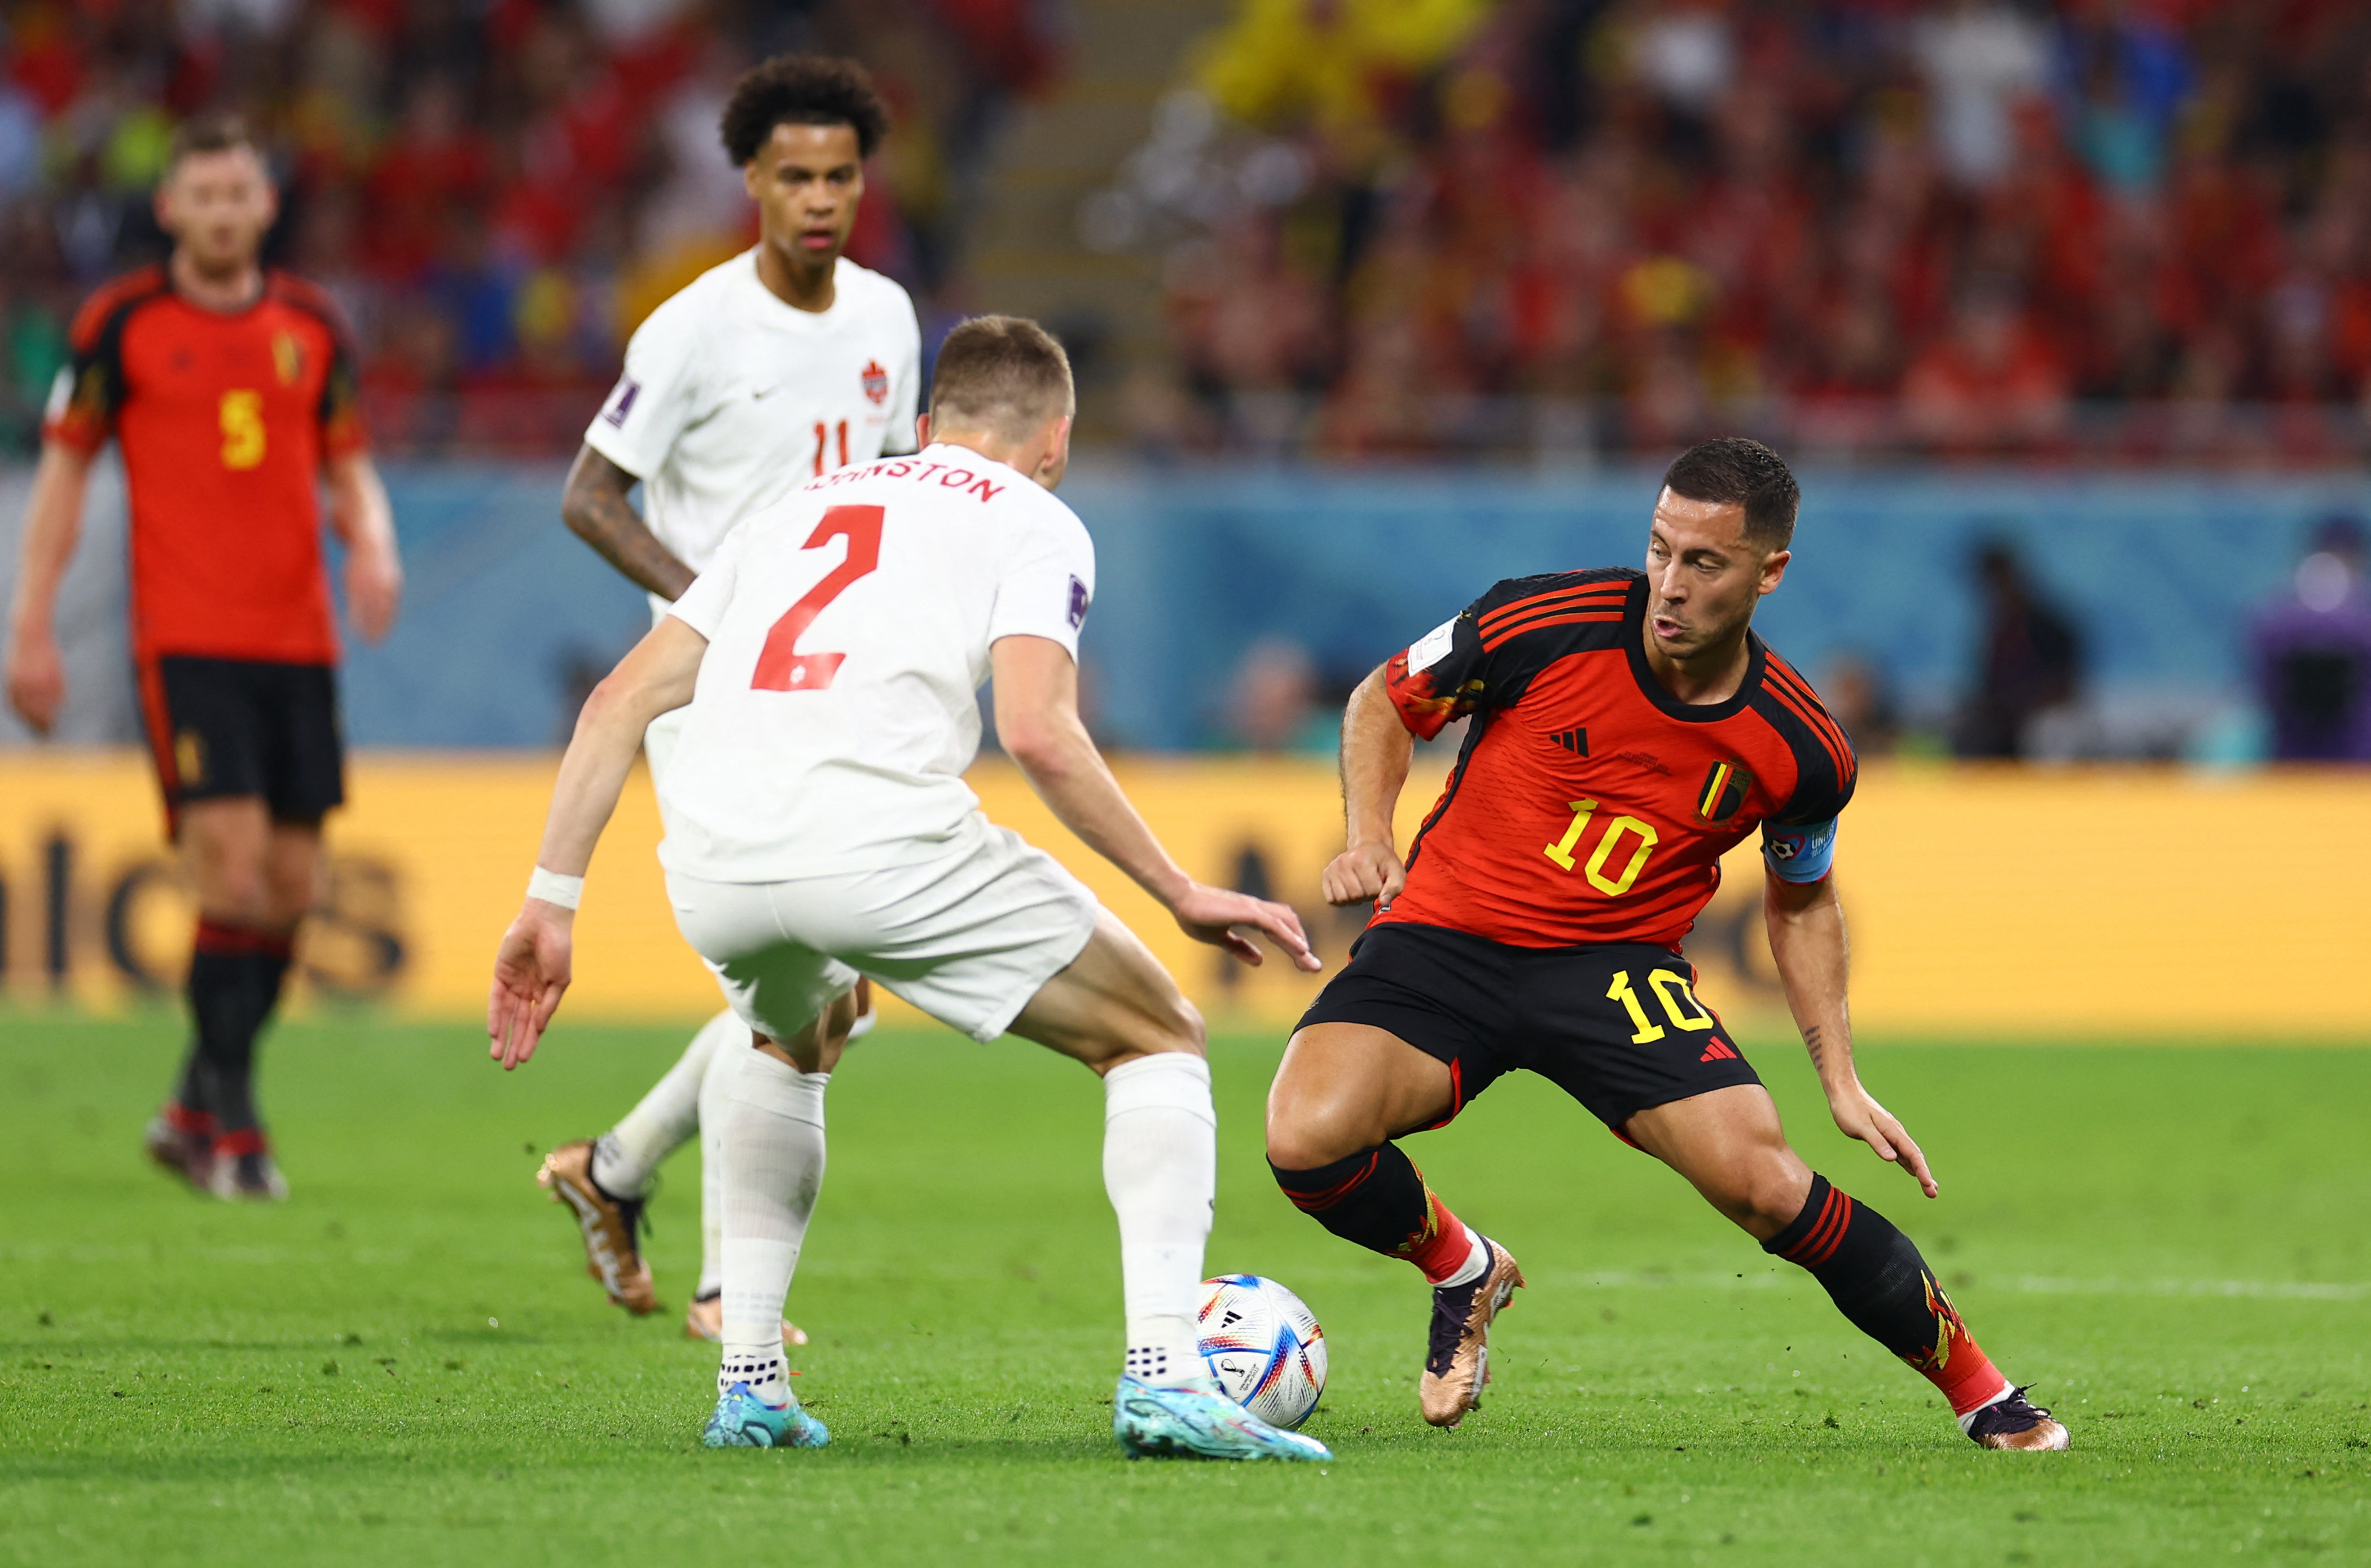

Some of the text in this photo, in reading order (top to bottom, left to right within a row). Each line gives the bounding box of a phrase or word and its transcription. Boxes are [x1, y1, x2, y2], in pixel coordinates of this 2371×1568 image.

[219, 389, 266, 469] 5
[813, 419, 849, 477] 11
[803, 460, 1006, 502] HNSTON
[750, 504, 885, 691] 2
[1544, 797, 1659, 897] 10
[1605, 968, 1714, 1044] 10
